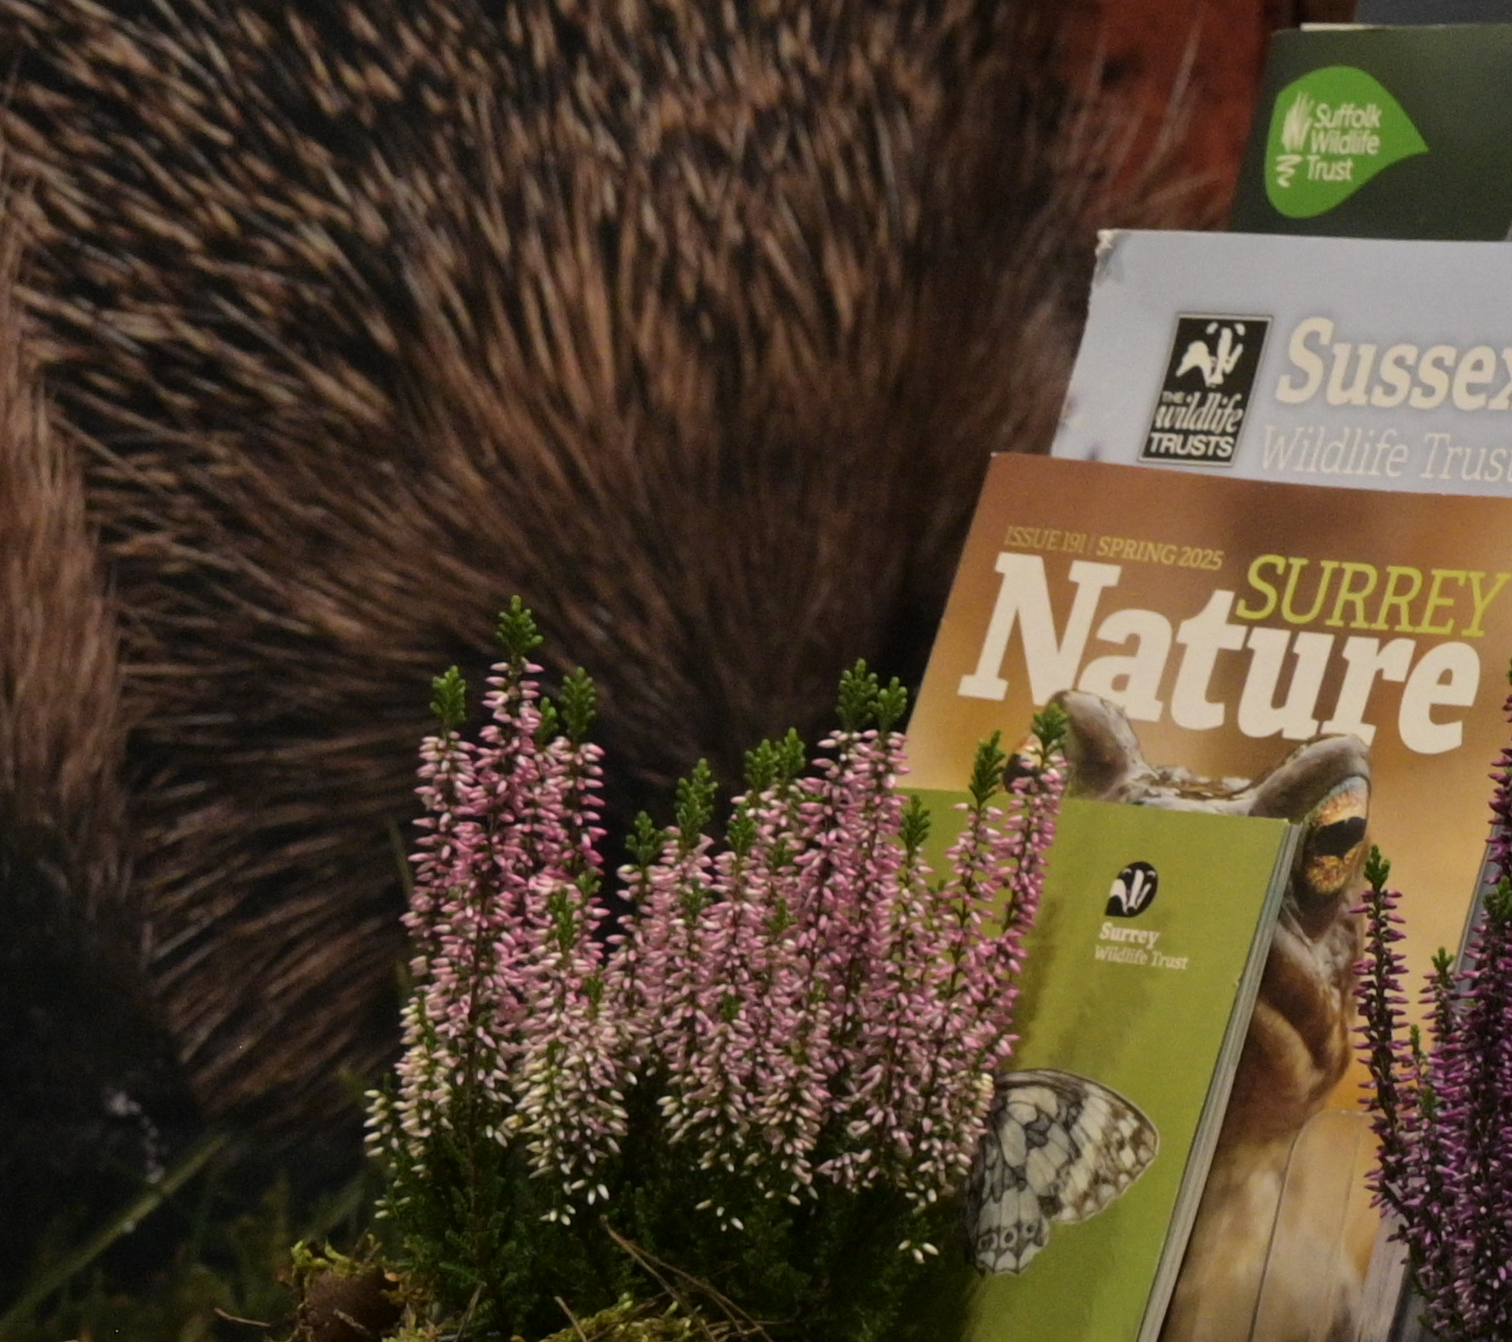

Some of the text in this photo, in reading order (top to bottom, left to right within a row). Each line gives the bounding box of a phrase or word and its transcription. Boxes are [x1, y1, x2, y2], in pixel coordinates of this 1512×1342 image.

[1314, 103, 1382, 128] Suffolk
[1311, 129, 1380, 156] Wildlife
[1306, 155, 1353, 181] Trust
[1154, 391, 1244, 434] wildlife
[1150, 431, 1234, 457] TRUSTS
[1261, 424, 1409, 477] Wildlife
[1004, 526, 1225, 571] ISSUE 191 SPRING 2025
[1236, 553, 1512, 637] SURREY
[958, 551, 1481, 754] Nature
[1099, 921, 1161, 950] Surrey
[1094, 944, 1189, 970] Wildlife Trust
